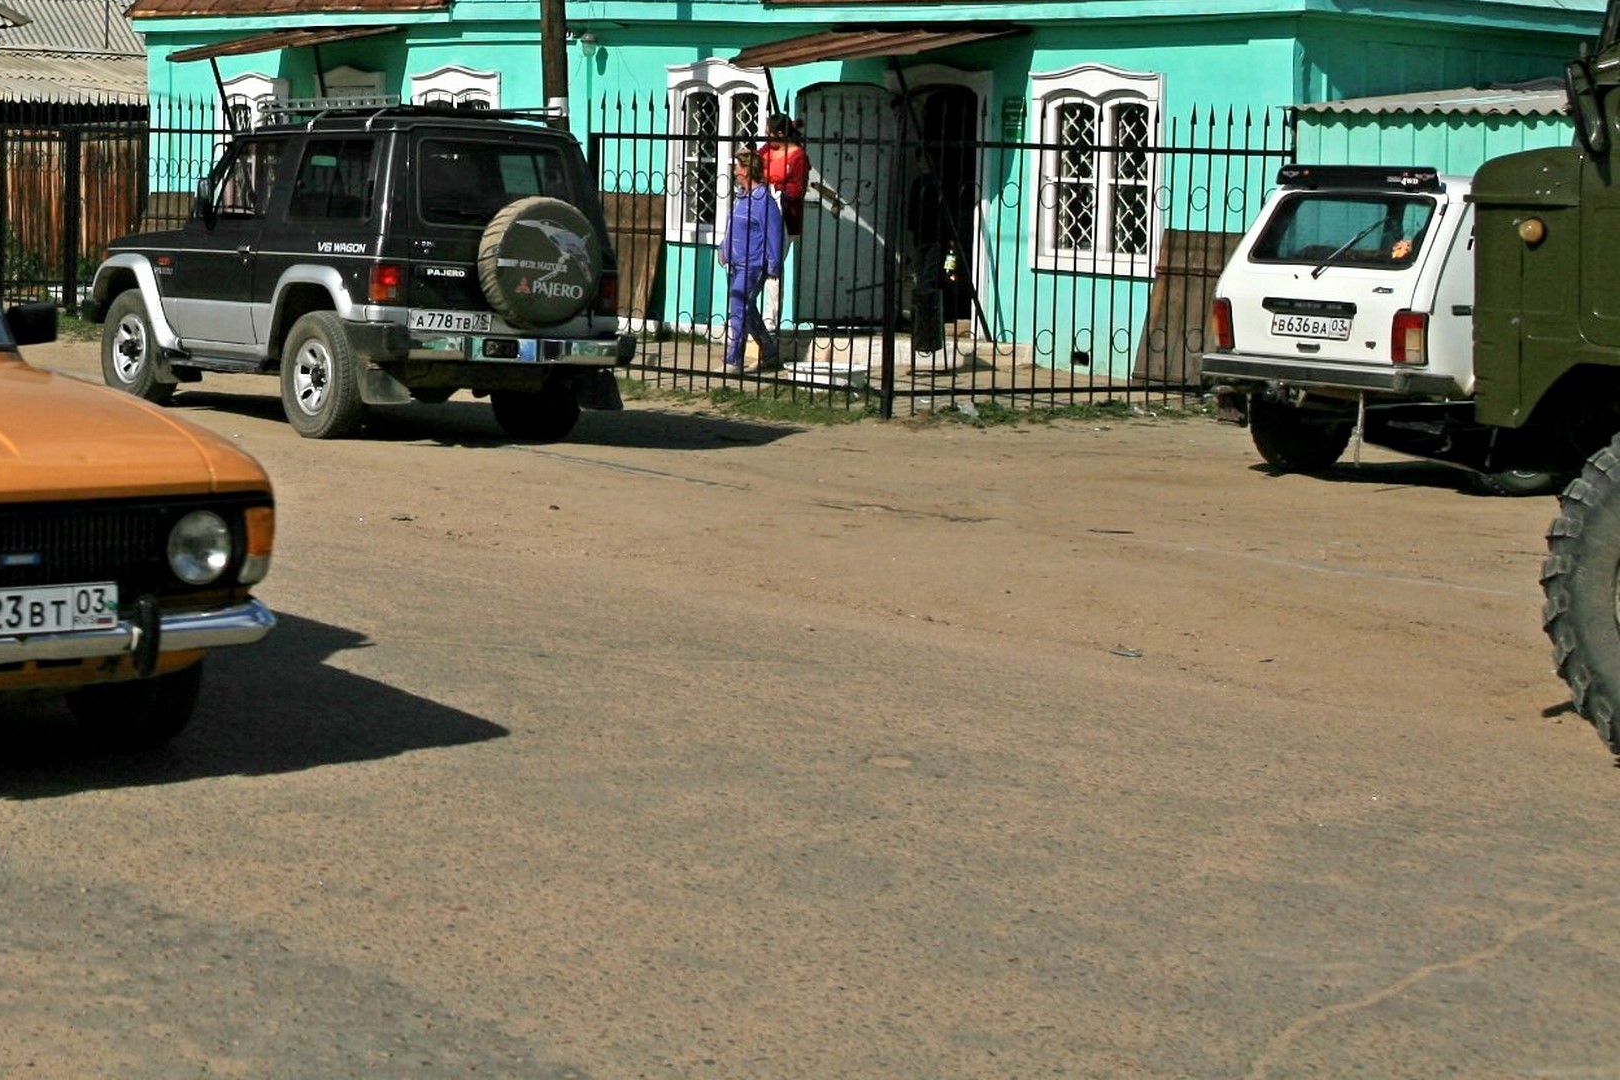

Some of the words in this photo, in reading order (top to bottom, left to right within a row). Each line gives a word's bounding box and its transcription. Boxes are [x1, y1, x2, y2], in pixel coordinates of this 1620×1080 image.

[317, 241, 333, 253] V6
[333, 243, 367, 253] WAGON
[427, 268, 466, 278] PAJERO
[532, 280, 584, 300] PAJERO
[76, 588, 106, 614] 03
